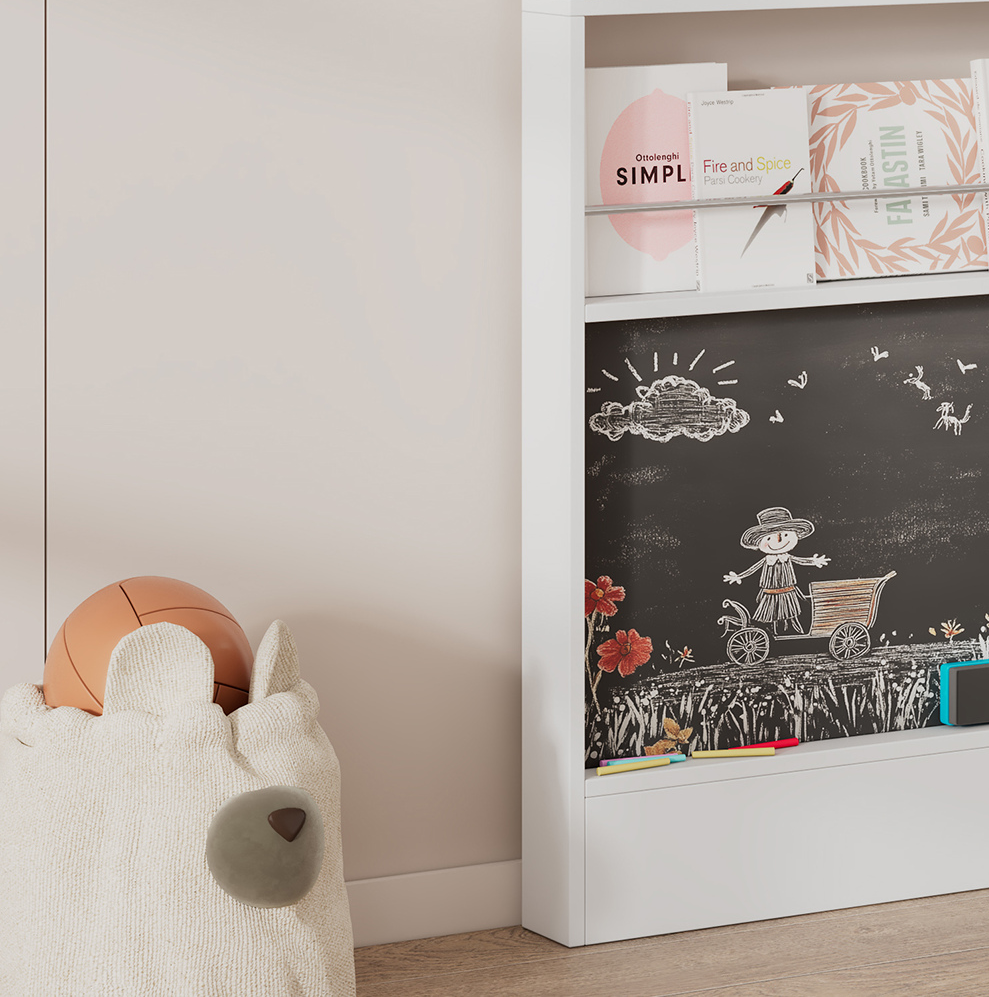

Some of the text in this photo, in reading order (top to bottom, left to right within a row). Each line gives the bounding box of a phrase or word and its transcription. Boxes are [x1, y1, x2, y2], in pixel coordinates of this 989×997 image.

[635, 152, 680, 163] Ottolenghi
[915, 130, 926, 171] TARA WIGLEY
[616, 164, 687, 186] SIMPL
[703, 156, 792, 174] Fire and Spice
[703, 173, 763, 186] Parsi Cookery
[879, 125, 913, 226] FAASTIN
